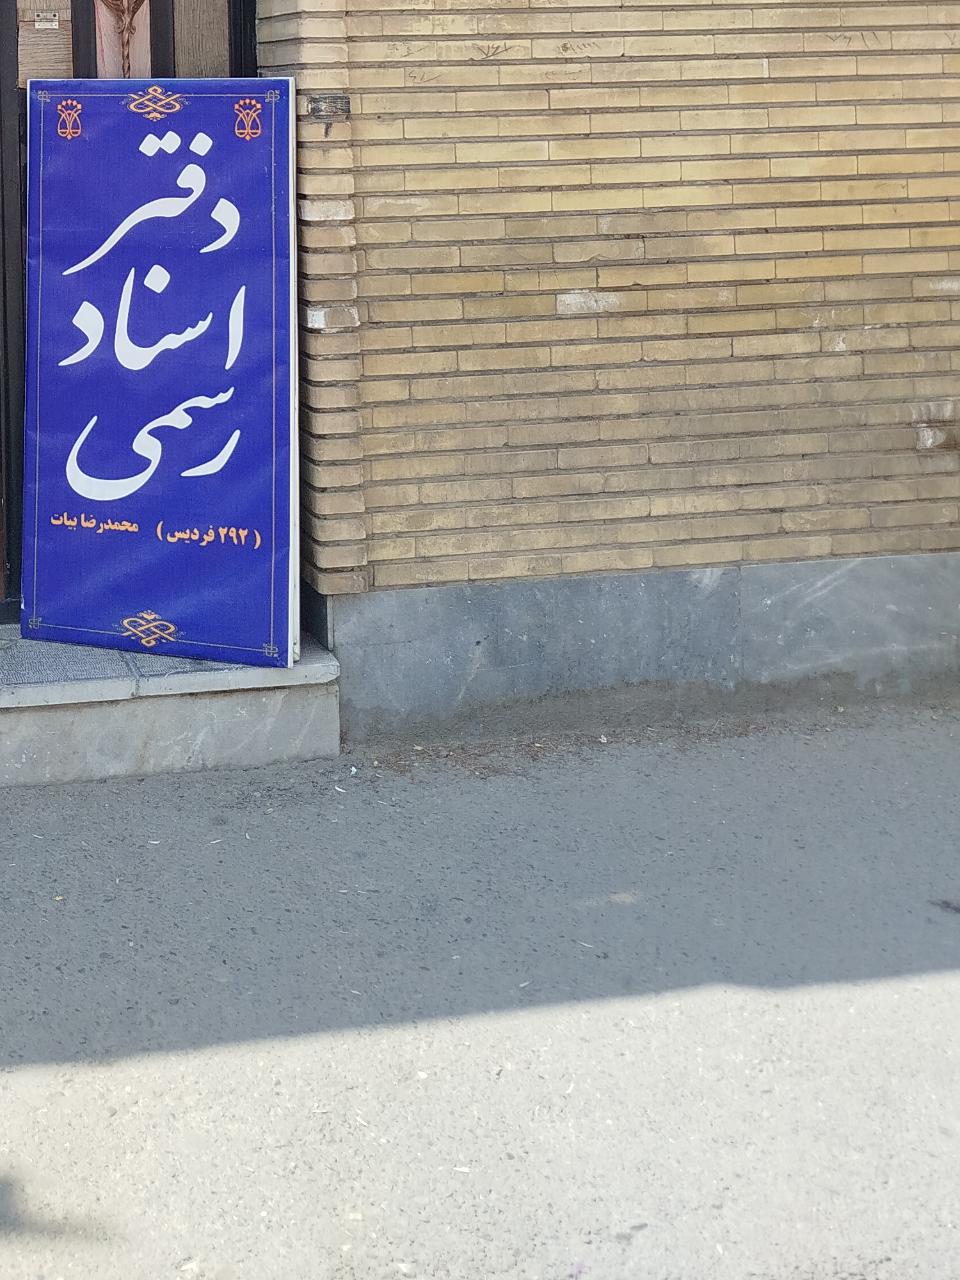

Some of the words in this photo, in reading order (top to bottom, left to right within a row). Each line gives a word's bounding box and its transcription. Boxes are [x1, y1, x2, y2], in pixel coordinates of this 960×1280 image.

[60, 129, 242, 277] دفتر
[56, 263, 247, 372] اسناد
[64, 385, 242, 502] رسمی
[165, 524, 216, 547] فردیس
